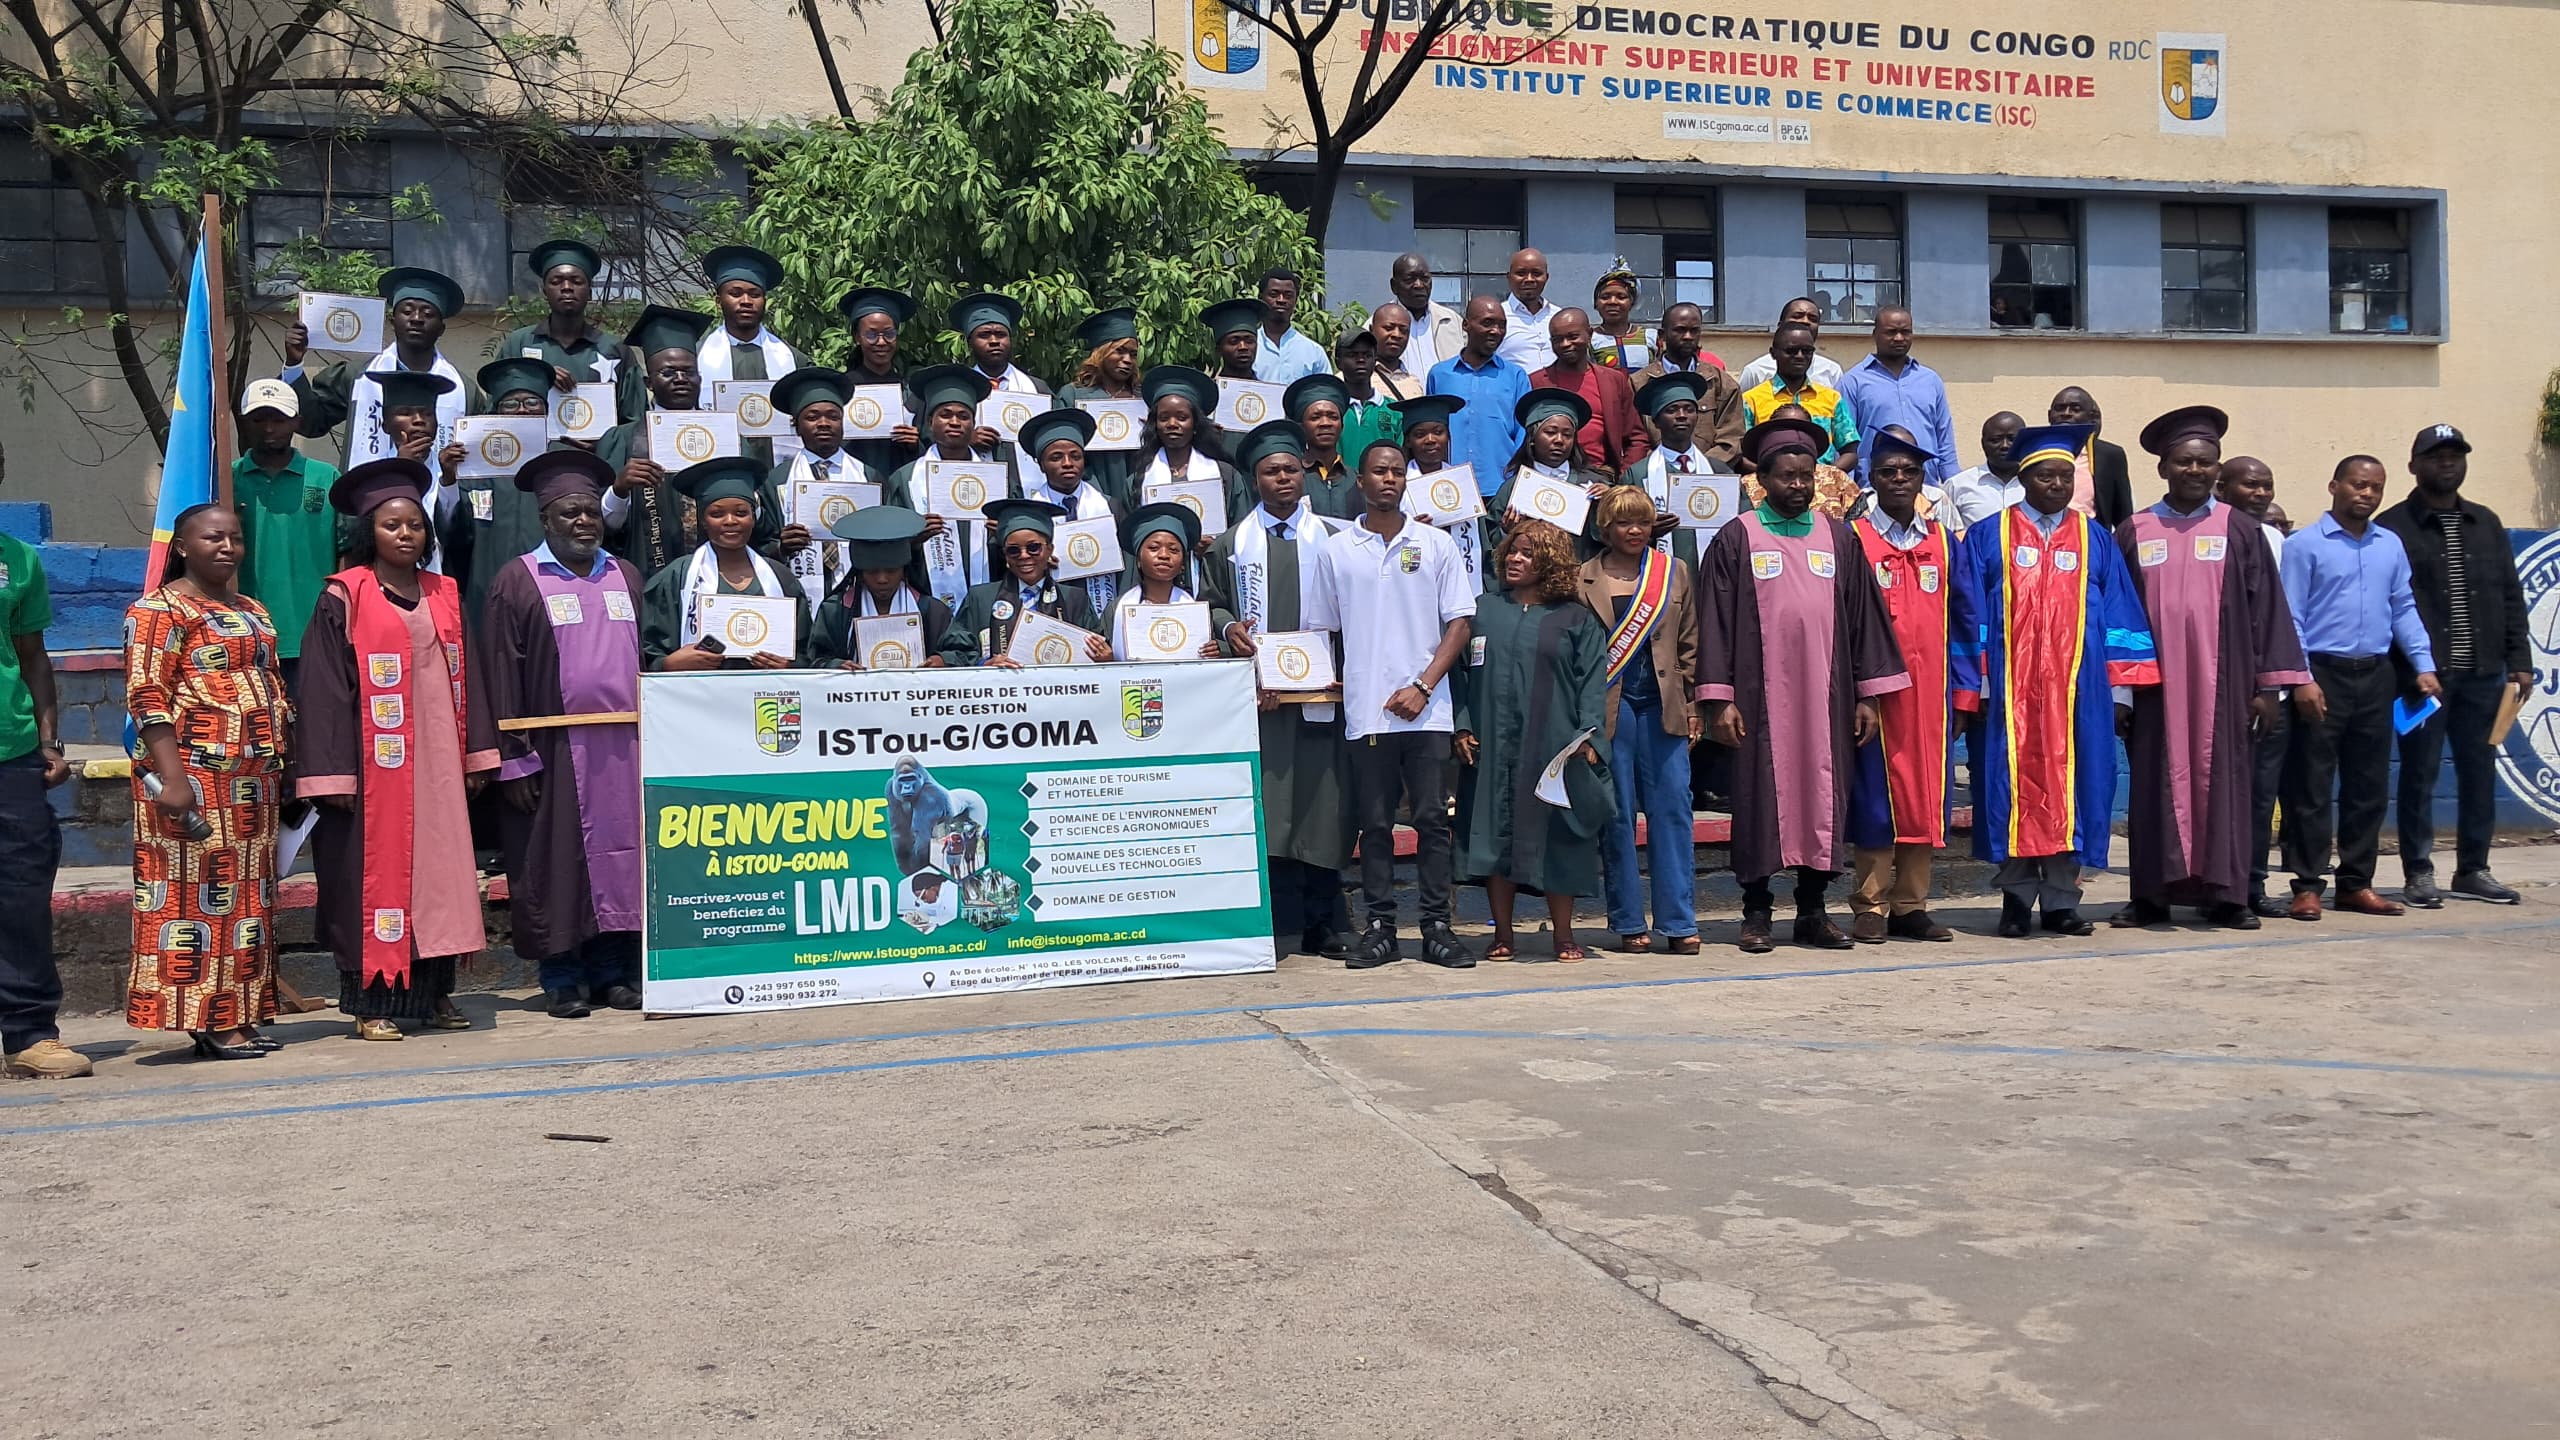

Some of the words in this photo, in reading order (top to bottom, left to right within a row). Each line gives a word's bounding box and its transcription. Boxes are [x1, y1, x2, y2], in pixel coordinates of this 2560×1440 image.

[1577, 5, 1880, 50] DEMOCRATIQUE
[1901, 25, 1949, 51] DU
[1970, 30, 2095, 58] CONGO
[2108, 40, 2152, 60] RDC
[1625, 47, 1798, 78] SUPERIEUR
[1814, 57, 1851, 82] ET
[1867, 62, 2095, 98] UNIVERSITAIRE
[1435, 64, 1585, 96] INSTITUT
[1602, 76, 1771, 106] SUPERIEUR
[1786, 90, 1823, 110] DE
[827, 690, 900, 703] INSTITUT
[906, 687, 993, 701] SUPERIEUR
[999, 686, 1018, 697] DE
[1023, 684, 1100, 696] TOURISME
[911, 706, 929, 716] ET
[935, 705, 954, 716] DE
[960, 703, 1027, 715] GESTION
[819, 719, 1098, 756] ISTou-G/GOMA
[1047, 775, 1097, 786] DOMAINE
[1100, 774, 1113, 784] DE
[1116, 772, 1171, 783] TOURISME
[1048, 790, 1061, 799] ET
[1064, 787, 1124, 798] HOTELERIE
[658, 798, 888, 848] BIENVENUE
[1050, 813, 1099, 824] DOMAINE
[1102, 812, 1116, 821] DE
[1119, 806, 1218, 820] L'ENVIRONNEMENT
[1050, 828, 1063, 837] ET
[1066, 824, 1120, 836] SCIENCES
[1122, 819, 1210, 833] AGRONOMIQUES
[1051, 851, 1100, 862] DOMAINE
[1103, 849, 1125, 859] DES
[1128, 846, 1181, 857] SCIENCES
[1184, 845, 1197, 854] ET
[706, 850, 720, 876] À
[726, 850, 848, 876] ISTOU-GOMA
[1051, 862, 1116, 875] NOUVELLES
[1119, 857, 1202, 870] TECHNOLOGIES
[667, 890, 768, 906] Inscrivez-vous
[772, 889, 785, 900] et
[794, 876, 891, 935] LMD
[1053, 894, 1105, 906] DOMAINE
[1108, 893, 1123, 902] DE
[1127, 890, 1176, 901] GESTION
[693, 907, 764, 920] beneficiez
[767, 905, 786, 916] du
[703, 922, 786, 938] programme
[1007, 928, 1146, 949] info@istougoma.ac.cd
[950, 979, 978, 987] Etage
[995, 972, 1036, 982] batiment
[1099, 966, 1120, 974] face
[749, 983, 772, 991] +243
[797, 991, 816, 999] 932
[818, 989, 837, 997] 272
